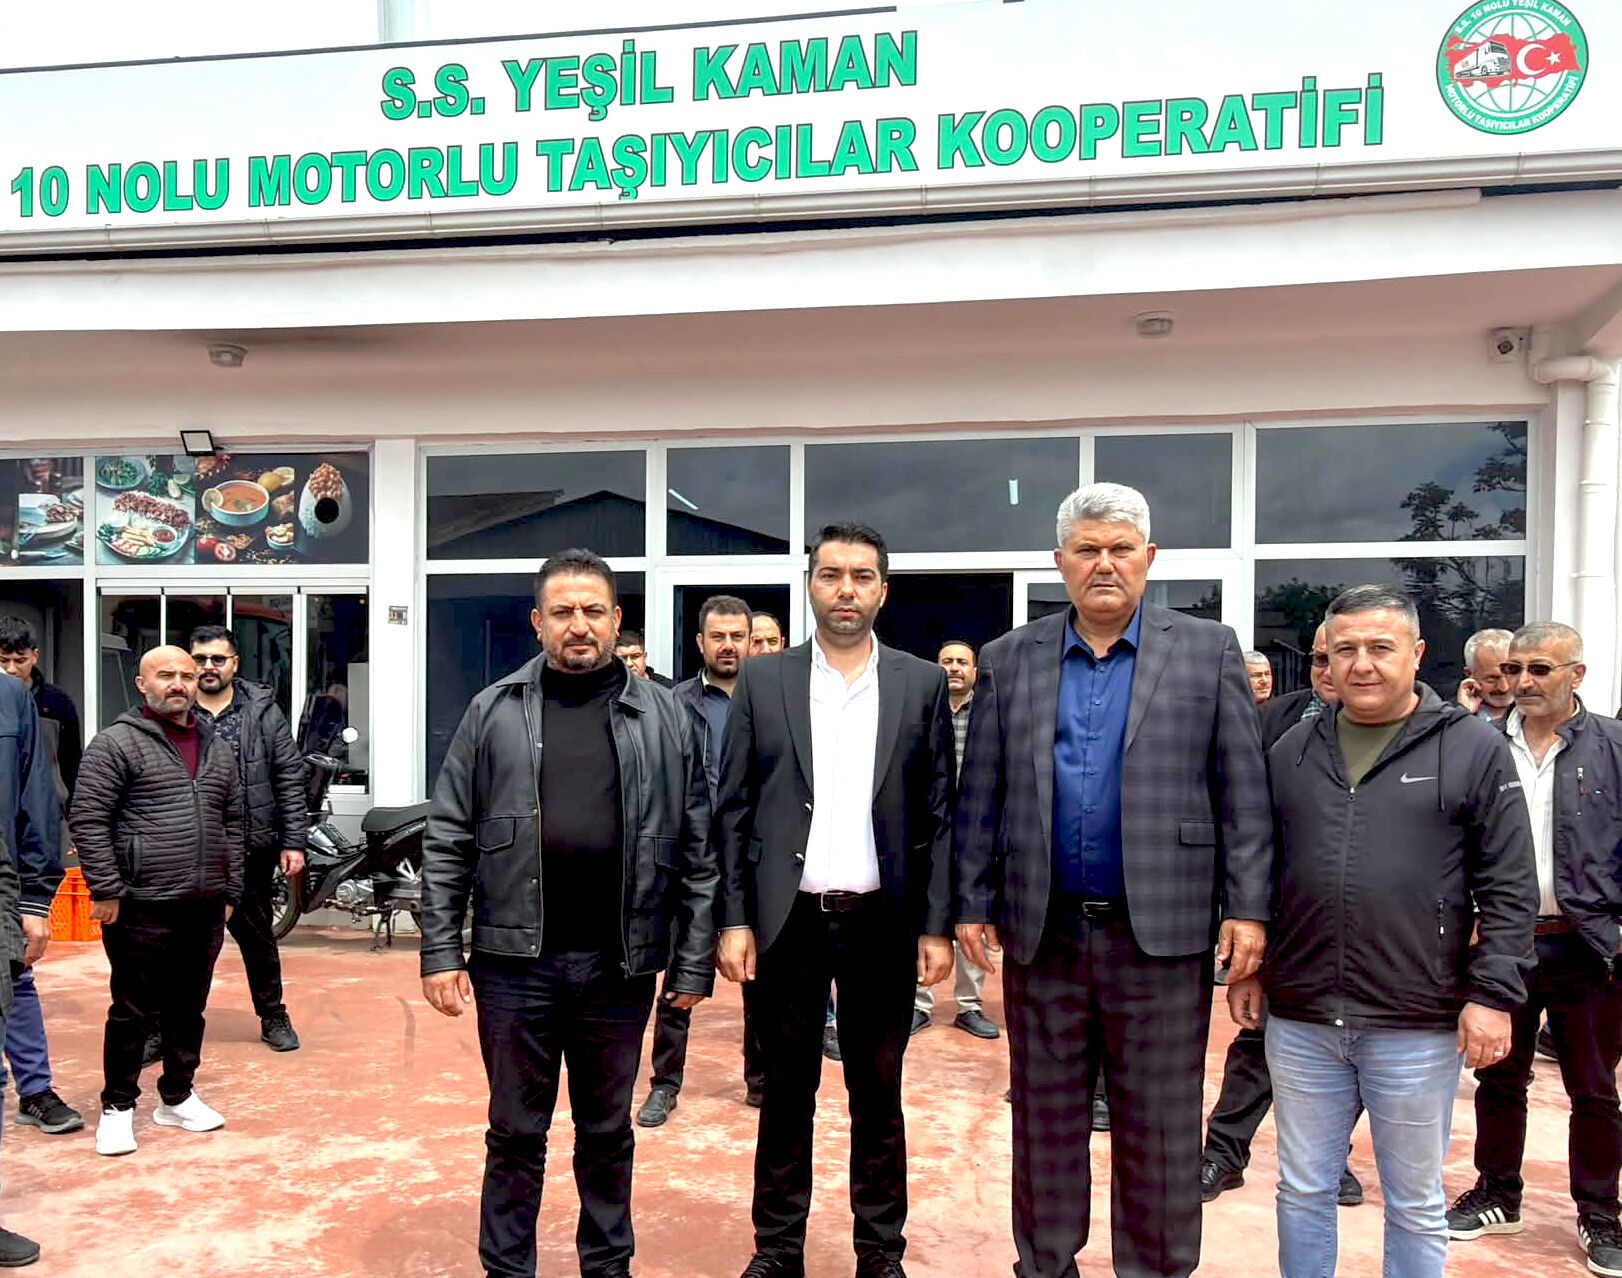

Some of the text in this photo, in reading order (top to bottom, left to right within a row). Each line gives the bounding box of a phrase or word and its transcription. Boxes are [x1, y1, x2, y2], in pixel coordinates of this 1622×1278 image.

[1471, 8, 1483, 20] 10
[1483, 0, 1511, 13] NOLU
[1541, 3, 1572, 27] KAMAN
[381, 30, 918, 121] S.S. YEŞİL KAMAN
[1446, 83, 1476, 121] MOTORLU
[11, 73, 1384, 217] 10 NOLU MOTORLU TAŞIYICILAR KOOPERATİFİ
